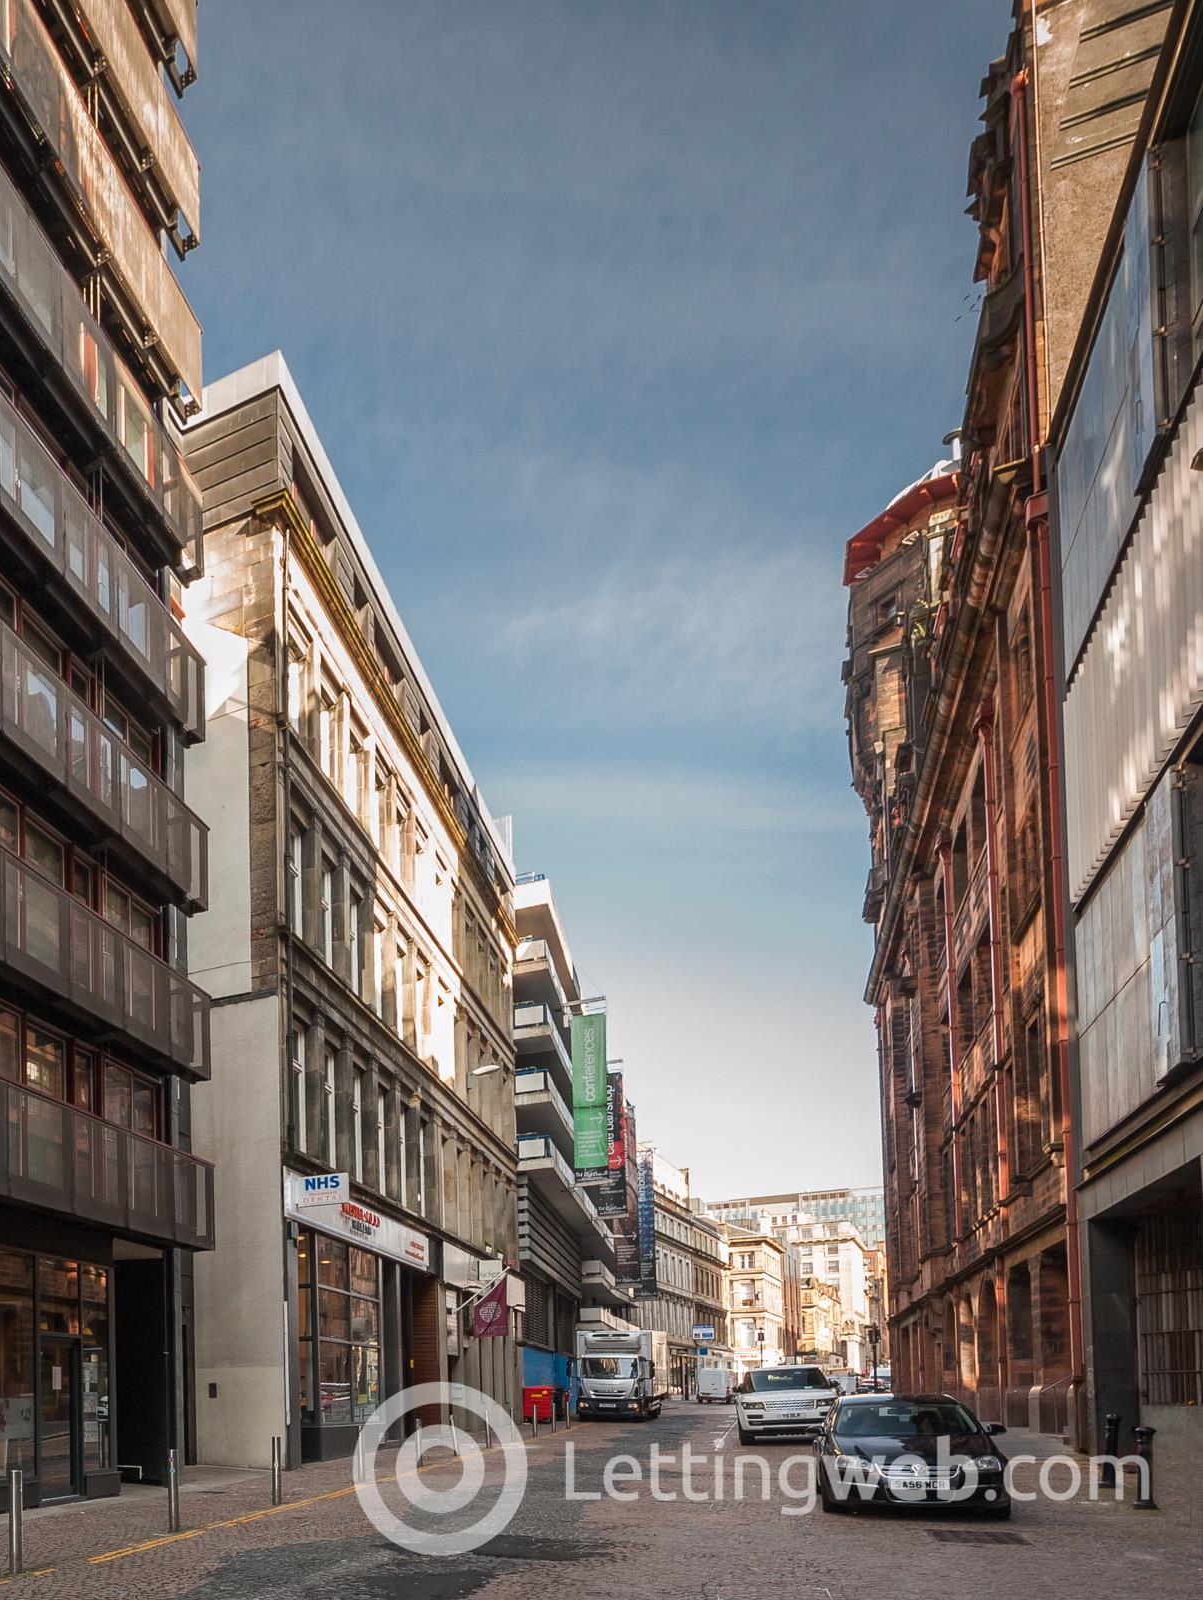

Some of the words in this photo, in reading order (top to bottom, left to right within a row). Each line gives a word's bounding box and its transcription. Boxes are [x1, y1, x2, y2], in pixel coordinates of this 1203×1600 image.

[583, 1027, 596, 1103] conferences
[304, 1175, 340, 1191] NHS
[895, 1480, 923, 1489] SA56
